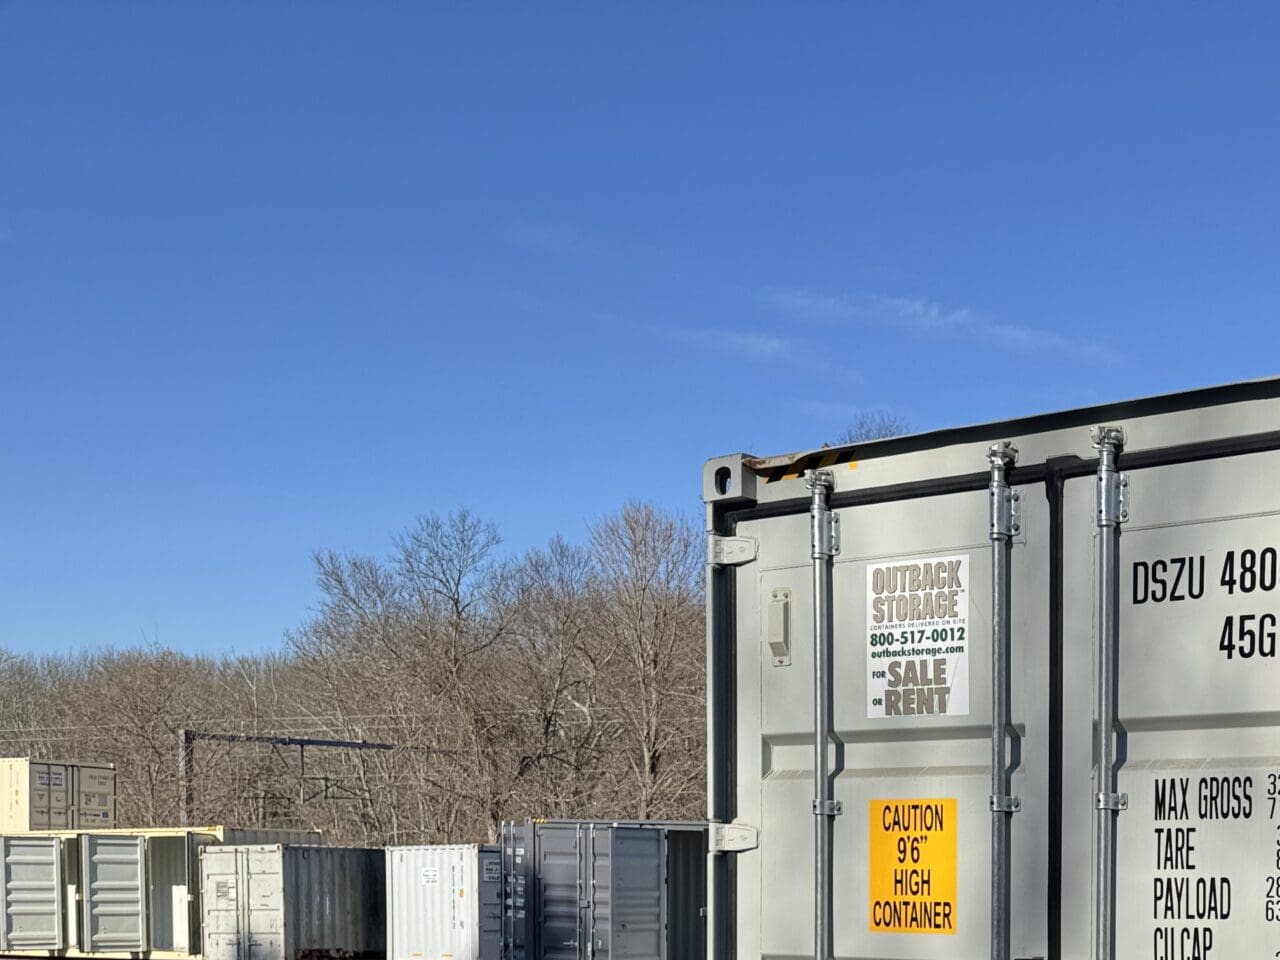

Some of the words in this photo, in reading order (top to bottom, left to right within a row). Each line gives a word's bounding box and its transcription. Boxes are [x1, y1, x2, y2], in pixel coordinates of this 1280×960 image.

[872, 560, 962, 595] OUTBACK
[1132, 555, 1205, 604] DSZU
[872, 590, 959, 624] STORAGE
[870, 622, 906, 631] CONTAINERS
[908, 620, 940, 628] DELIVERED
[870, 627, 966, 646] 800-517-0012
[871, 645, 964, 658] outbackstorage.com
[872, 670, 886, 679] FOR
[887, 658, 947, 689] SALE
[872, 698, 883, 706] OR
[884, 686, 950, 716] RENT
[1154, 777, 1189, 821] MAX
[1199, 776, 1253, 820] GROSS
[882, 804, 943, 832] CAUTION
[1154, 827, 1196, 870] TARE
[894, 869, 931, 896] HIGH
[1153, 877, 1231, 920] PAYLOAD
[873, 900, 952, 929] CONTAINER
